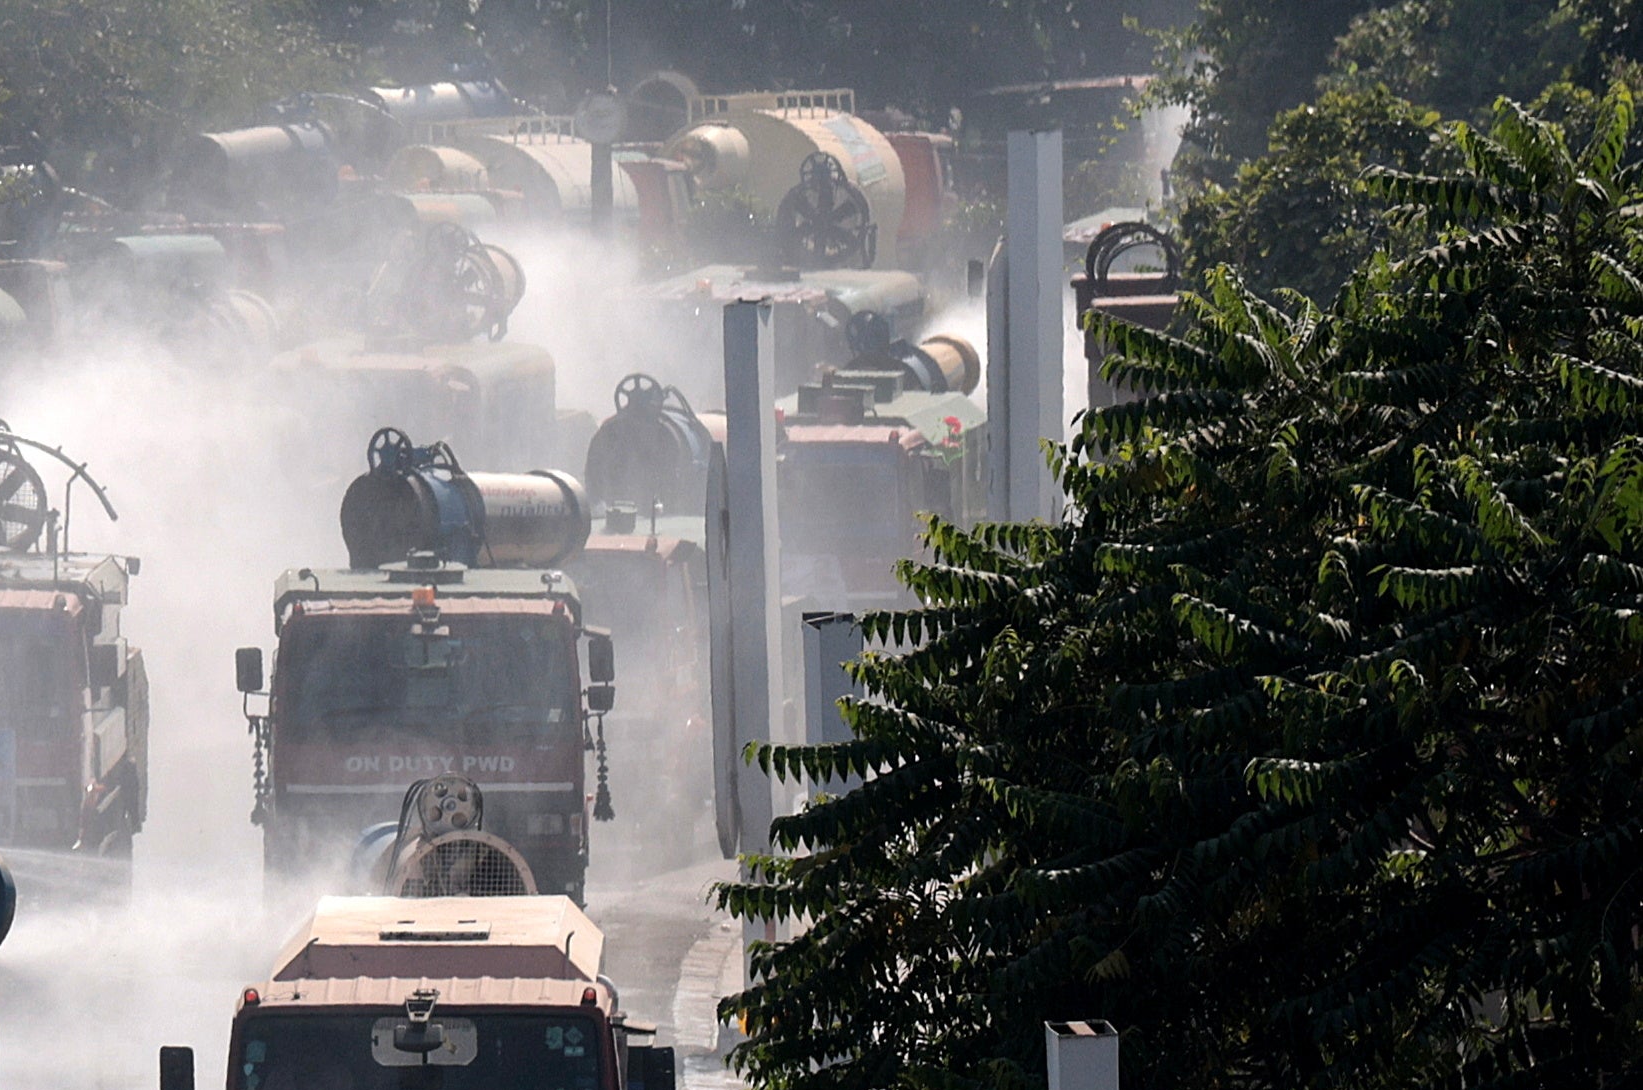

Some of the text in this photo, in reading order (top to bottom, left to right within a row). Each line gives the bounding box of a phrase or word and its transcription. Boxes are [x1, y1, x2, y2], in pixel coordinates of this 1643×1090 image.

[346, 757, 515, 772] ON DUTY PWD
